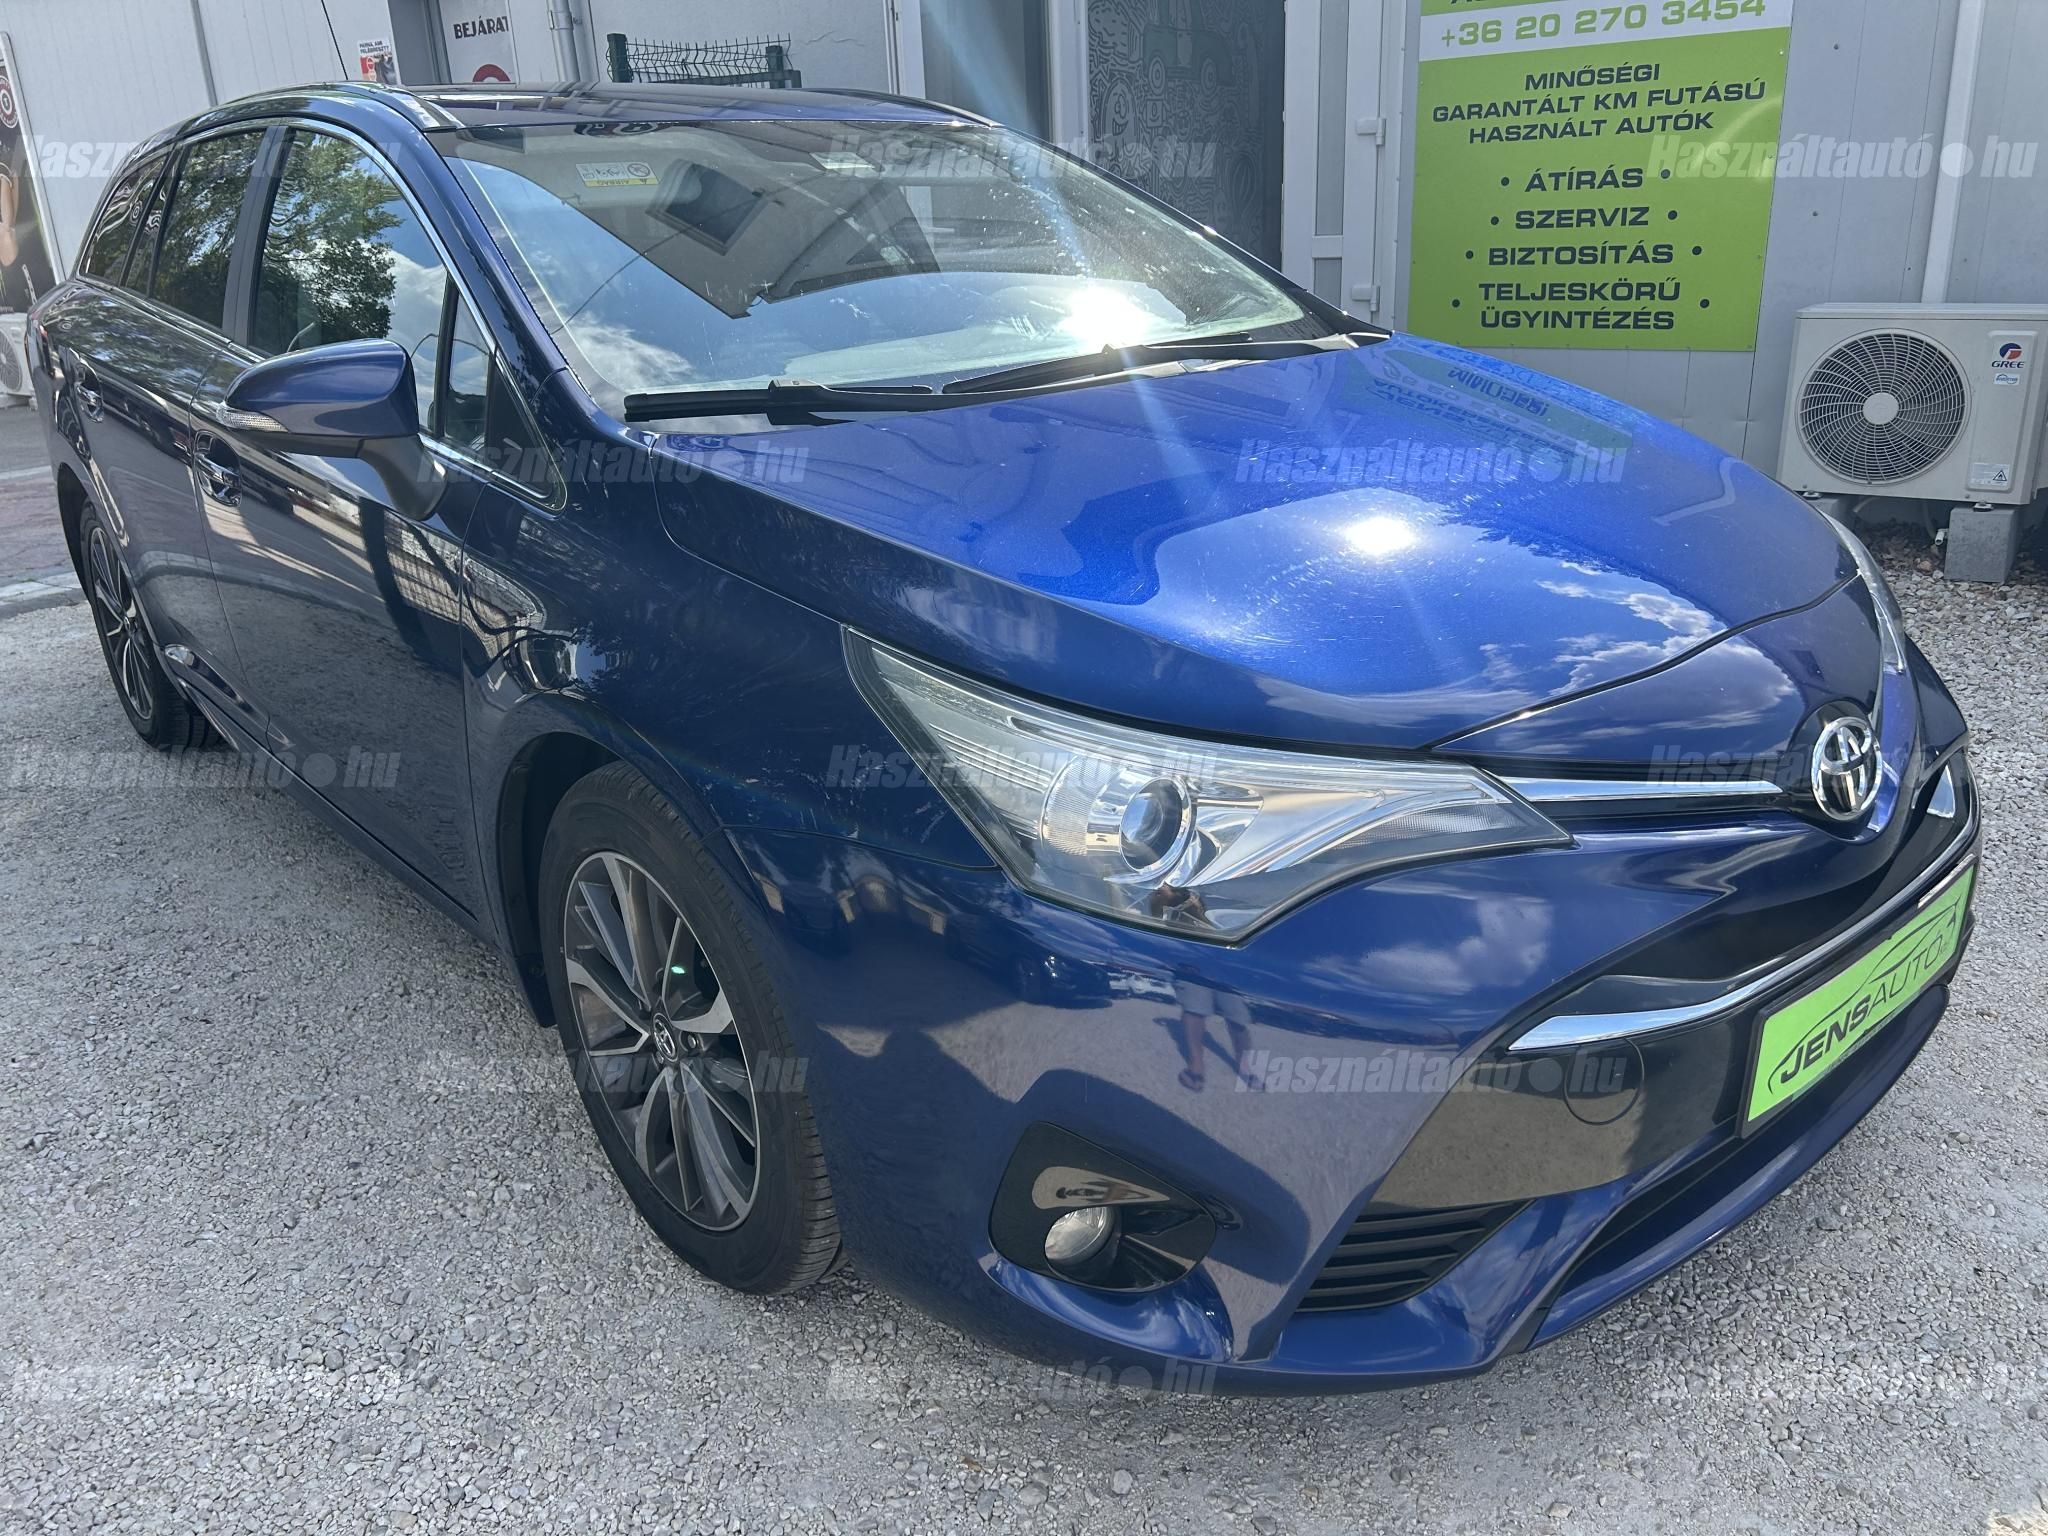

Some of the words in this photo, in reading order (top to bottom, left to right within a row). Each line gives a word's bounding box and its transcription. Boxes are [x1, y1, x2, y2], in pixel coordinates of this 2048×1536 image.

[1441, 20, 1502, 47] +36
[1515, 13, 1561, 40] 20
[1574, 5, 1647, 34] 270
[1661, 0, 1765, 26] 3454
[1525, 63, 1660, 91] MINŐSÉGI
[1432, 93, 1585, 123] GARANTÁLT
[1594, 92, 1637, 111] KM
[1647, 77, 1766, 107] FUTÁSÚ
[1469, 117, 1607, 144] HASZNÁLT
[1615, 111, 1714, 136] AUTÓK
[1524, 166, 1643, 192] ÁTÍRÁS
[1514, 207, 1650, 229] SZERVIZ
[1488, 240, 1674, 266] BIZTOSÍTÁS
[1478, 277, 1681, 302] TELJESKÖRŰ
[1480, 306, 1675, 330] ÜGYINTÉZÉS
[1991, 360, 2025, 369] GREE
